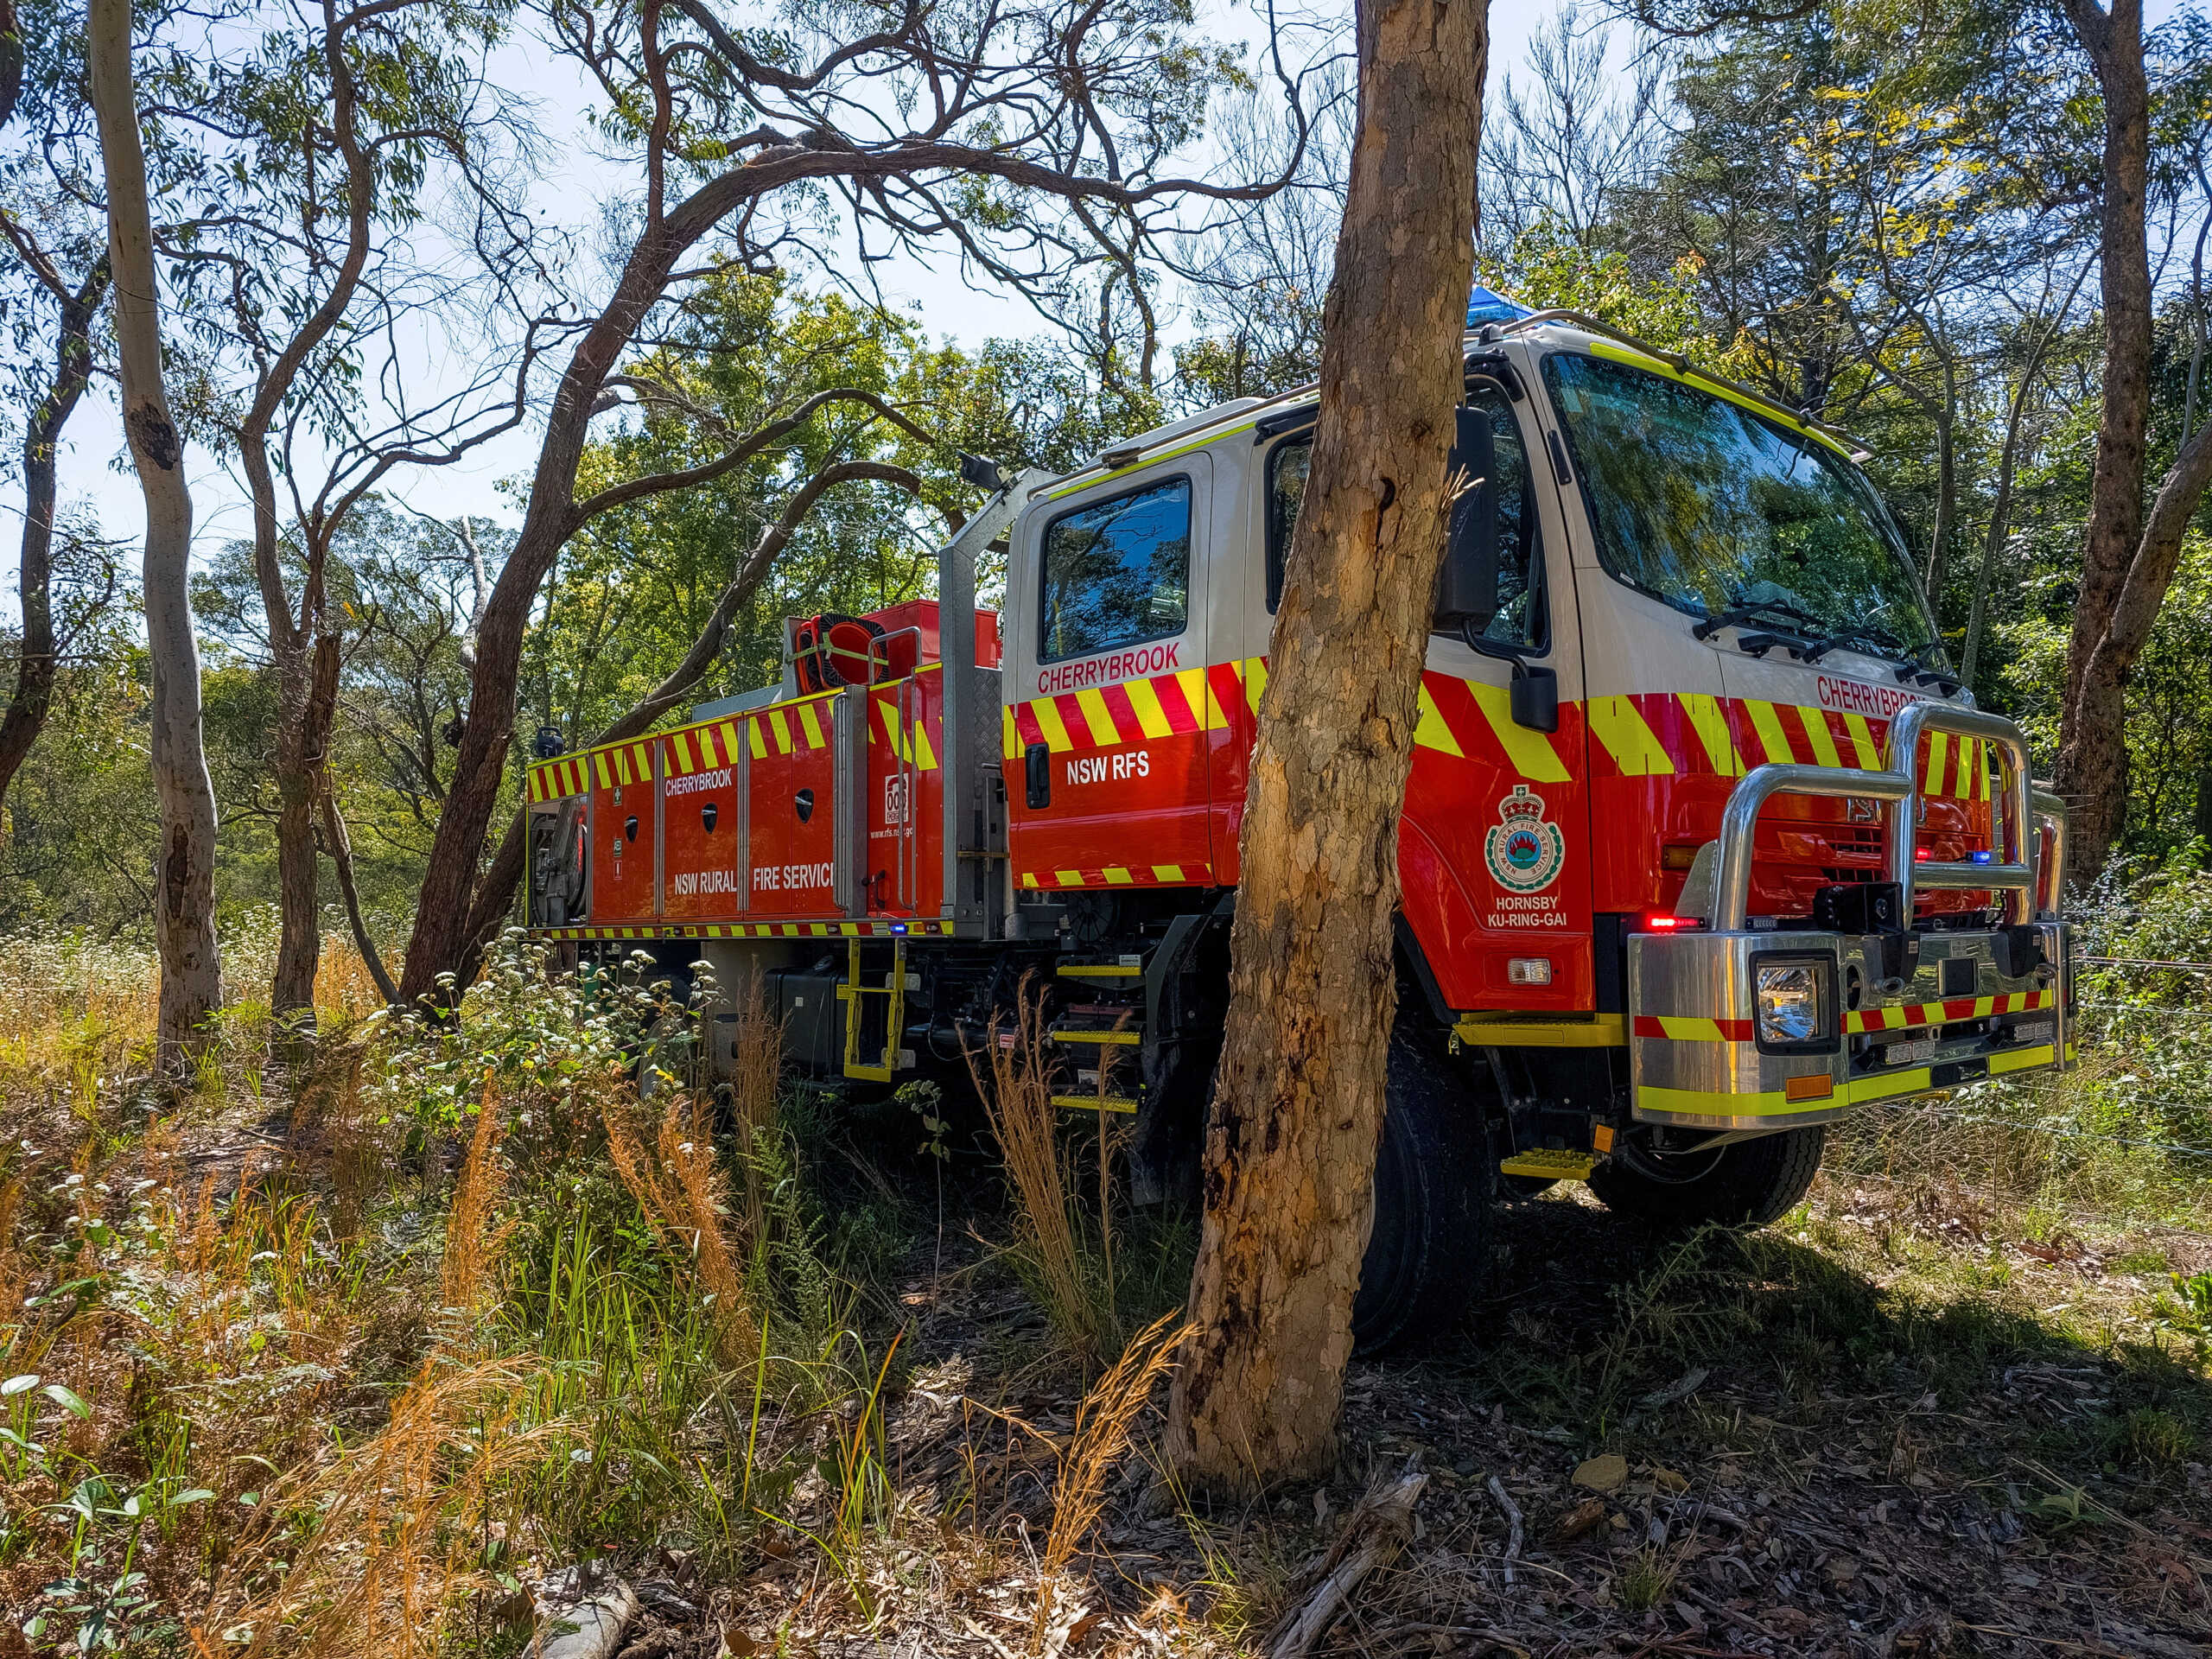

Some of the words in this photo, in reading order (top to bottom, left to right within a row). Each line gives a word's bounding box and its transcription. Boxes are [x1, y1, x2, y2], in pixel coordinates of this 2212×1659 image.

[1038, 642, 1179, 694] CHERRYBROOK
[1817, 676, 1926, 716] CHERRYBRO
[665, 767, 732, 797] CHERRYBROOK
[1067, 756, 1108, 785] NSW
[1112, 750, 1150, 780] RFS
[1498, 825, 1519, 854] RURAL
[1521, 823, 1541, 836] FIRE
[1500, 856, 1517, 875] NSW
[1531, 835, 1549, 875] SERVICE
[675, 873, 698, 895] NSW
[700, 870, 738, 893] RURAL
[753, 866, 780, 891] FIRE
[783, 862, 834, 890] SERVIC
[1496, 896, 1559, 910] HORNSBY
[1488, 912, 1567, 927] KU-RING-GAI
